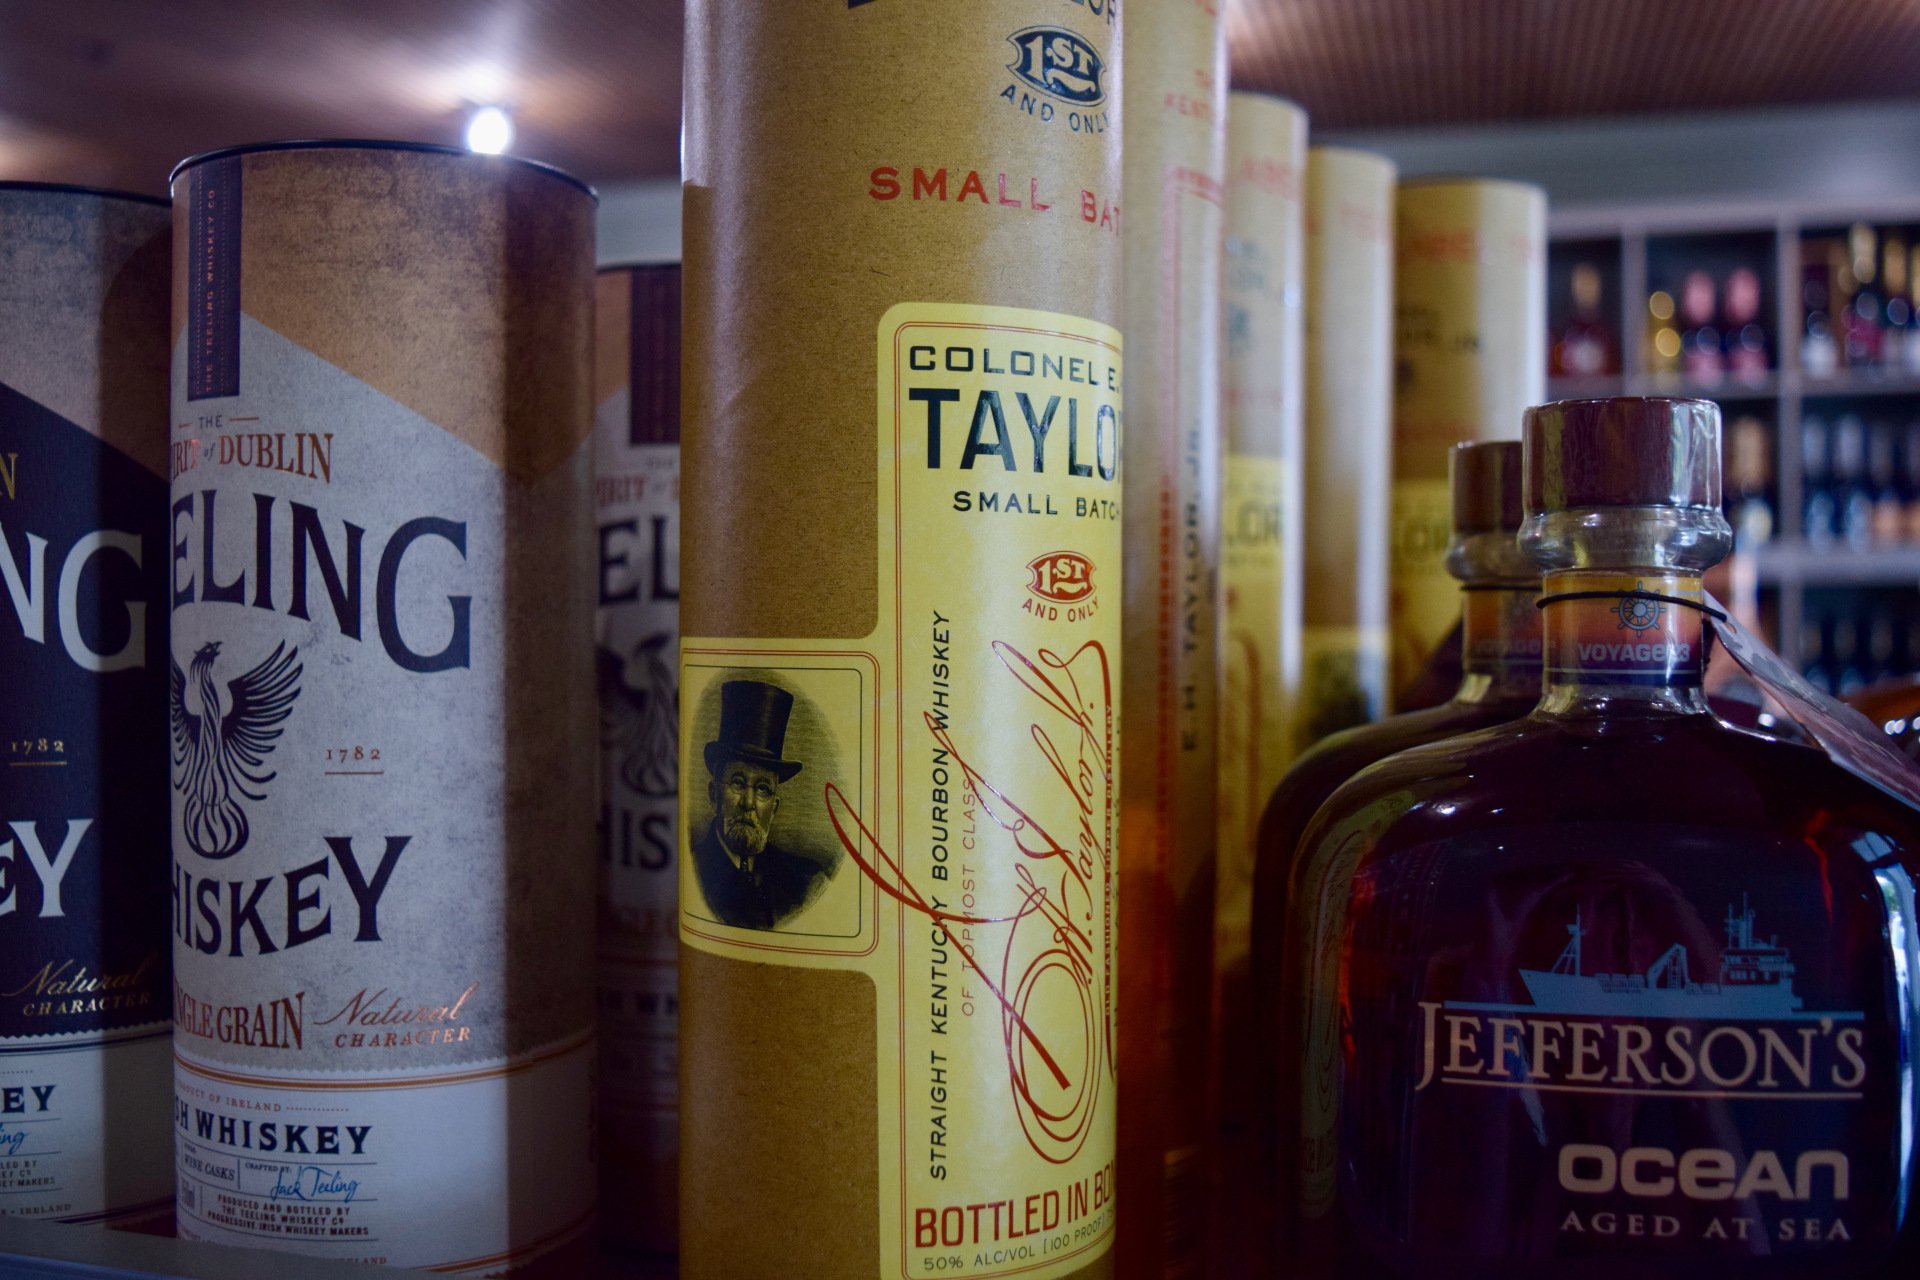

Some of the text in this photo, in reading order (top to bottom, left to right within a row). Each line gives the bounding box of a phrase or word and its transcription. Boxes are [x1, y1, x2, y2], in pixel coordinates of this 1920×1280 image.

[1001, 84, 1054, 122] AND
[868, 166, 1051, 211] SMALL
[206, 290, 214, 354] TEELING
[909, 346, 1099, 386] COLONEL
[198, 415, 223, 428] THE
[909, 388, 1121, 483] TAYLO
[219, 433, 334, 483] DUBLIN
[953, 490, 1058, 515] SMALL
[1022, 597, 1098, 624] AND ONLY
[12, 738, 64, 754] 1782
[325, 745, 381, 764] 1782
[1105, 807, 1113, 871] COPPER
[930, 610, 950, 1181] STRAIGHT KENTUCKY BOURBON WHISKEY
[962, 778, 976, 1017] OF TOPMOST CLASS
[1104, 882, 1112, 976] FASHIONED
[1, 951, 158, 997] Natural
[23, 995, 150, 1017] CHARACTER
[216, 992, 305, 1050] GRAIN
[313, 980, 480, 1026] Natural
[335, 1026, 471, 1049] CHARACTER
[1416, 1001, 1866, 1091] JEFFERSON'S
[226, 1096, 281, 1112] IRELAND
[196, 1107, 372, 1155] WHISKEY
[204, 1163, 236, 1181] CASKS
[20, 1202, 72, 1216] IRELAND
[218, 1194, 350, 1216] PRODUCED AND BOTTLED BY
[240, 1209, 276, 1222] TEELING
[281, 1215, 326, 1226] WHISKEY
[915, 1190, 1060, 1250] BOTTLED
[1067, 1177, 1089, 1224] IN
[259, 1221, 282, 1233] IRISH
[285, 1225, 326, 1236] WHISKEY
[330, 1226, 369, 1236] MAKERS
[1560, 1210, 1852, 1241] AGED AT SEA
[924, 1256, 964, 1271] 50%
[974, 1247, 1036, 1267] ALC/VOL
